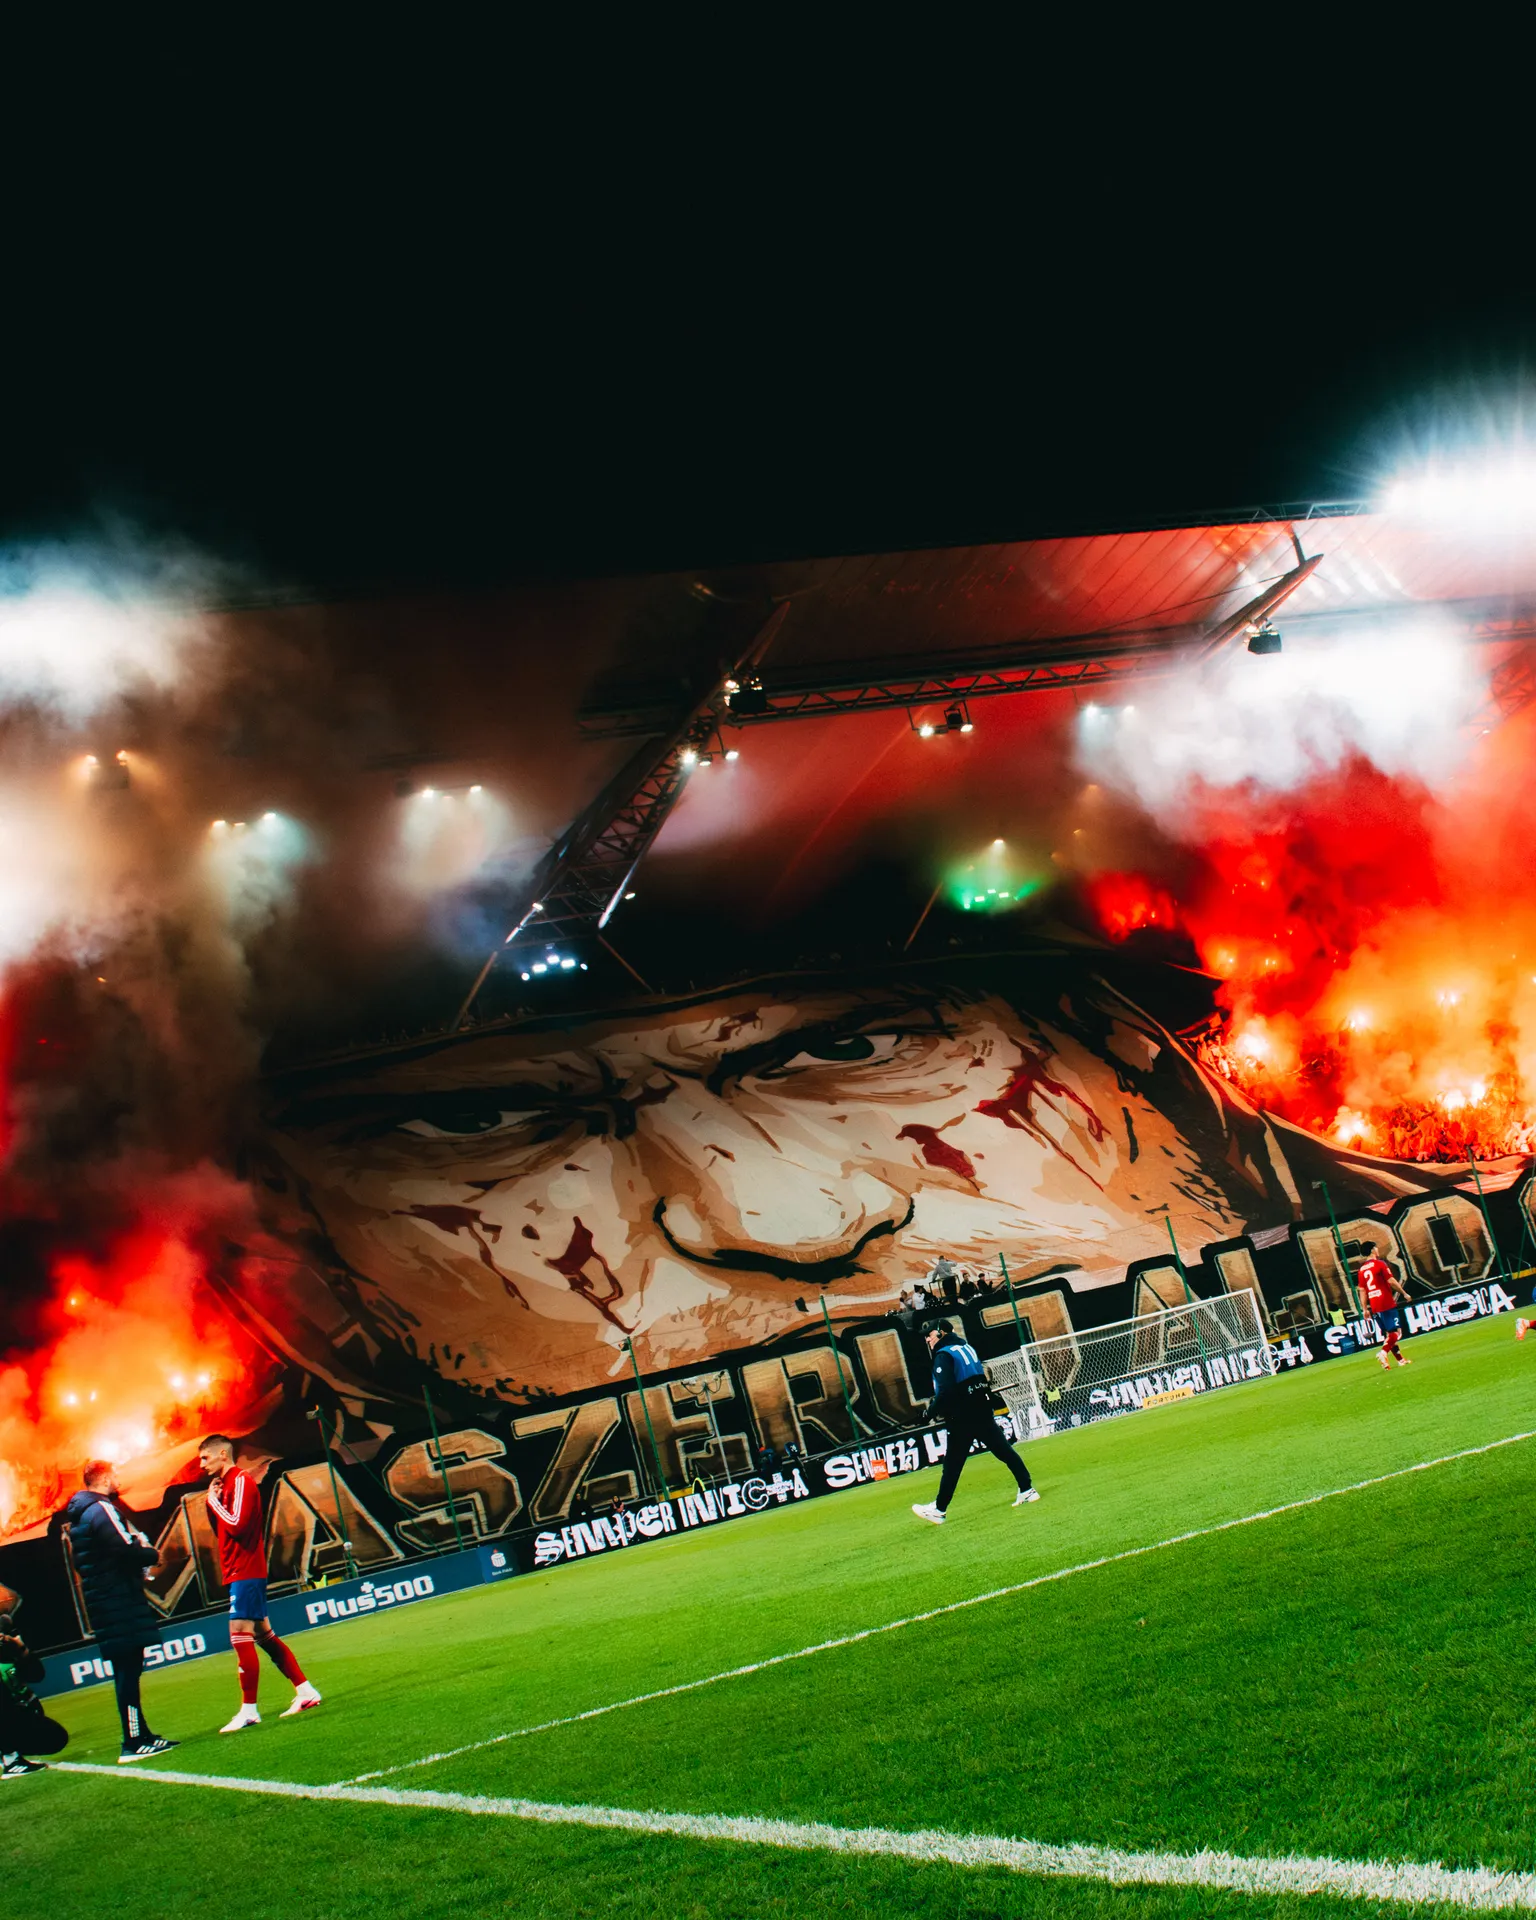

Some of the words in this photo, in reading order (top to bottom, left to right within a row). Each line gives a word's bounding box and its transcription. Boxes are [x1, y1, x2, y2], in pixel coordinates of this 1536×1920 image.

[1126, 1194, 1497, 1374] ALBO
[1363, 1269, 1377, 1291] 2
[1393, 1317, 1400, 1327] 2
[305, 1574, 435, 1625] Plus500
[69, 1633, 206, 1685] Pl500
